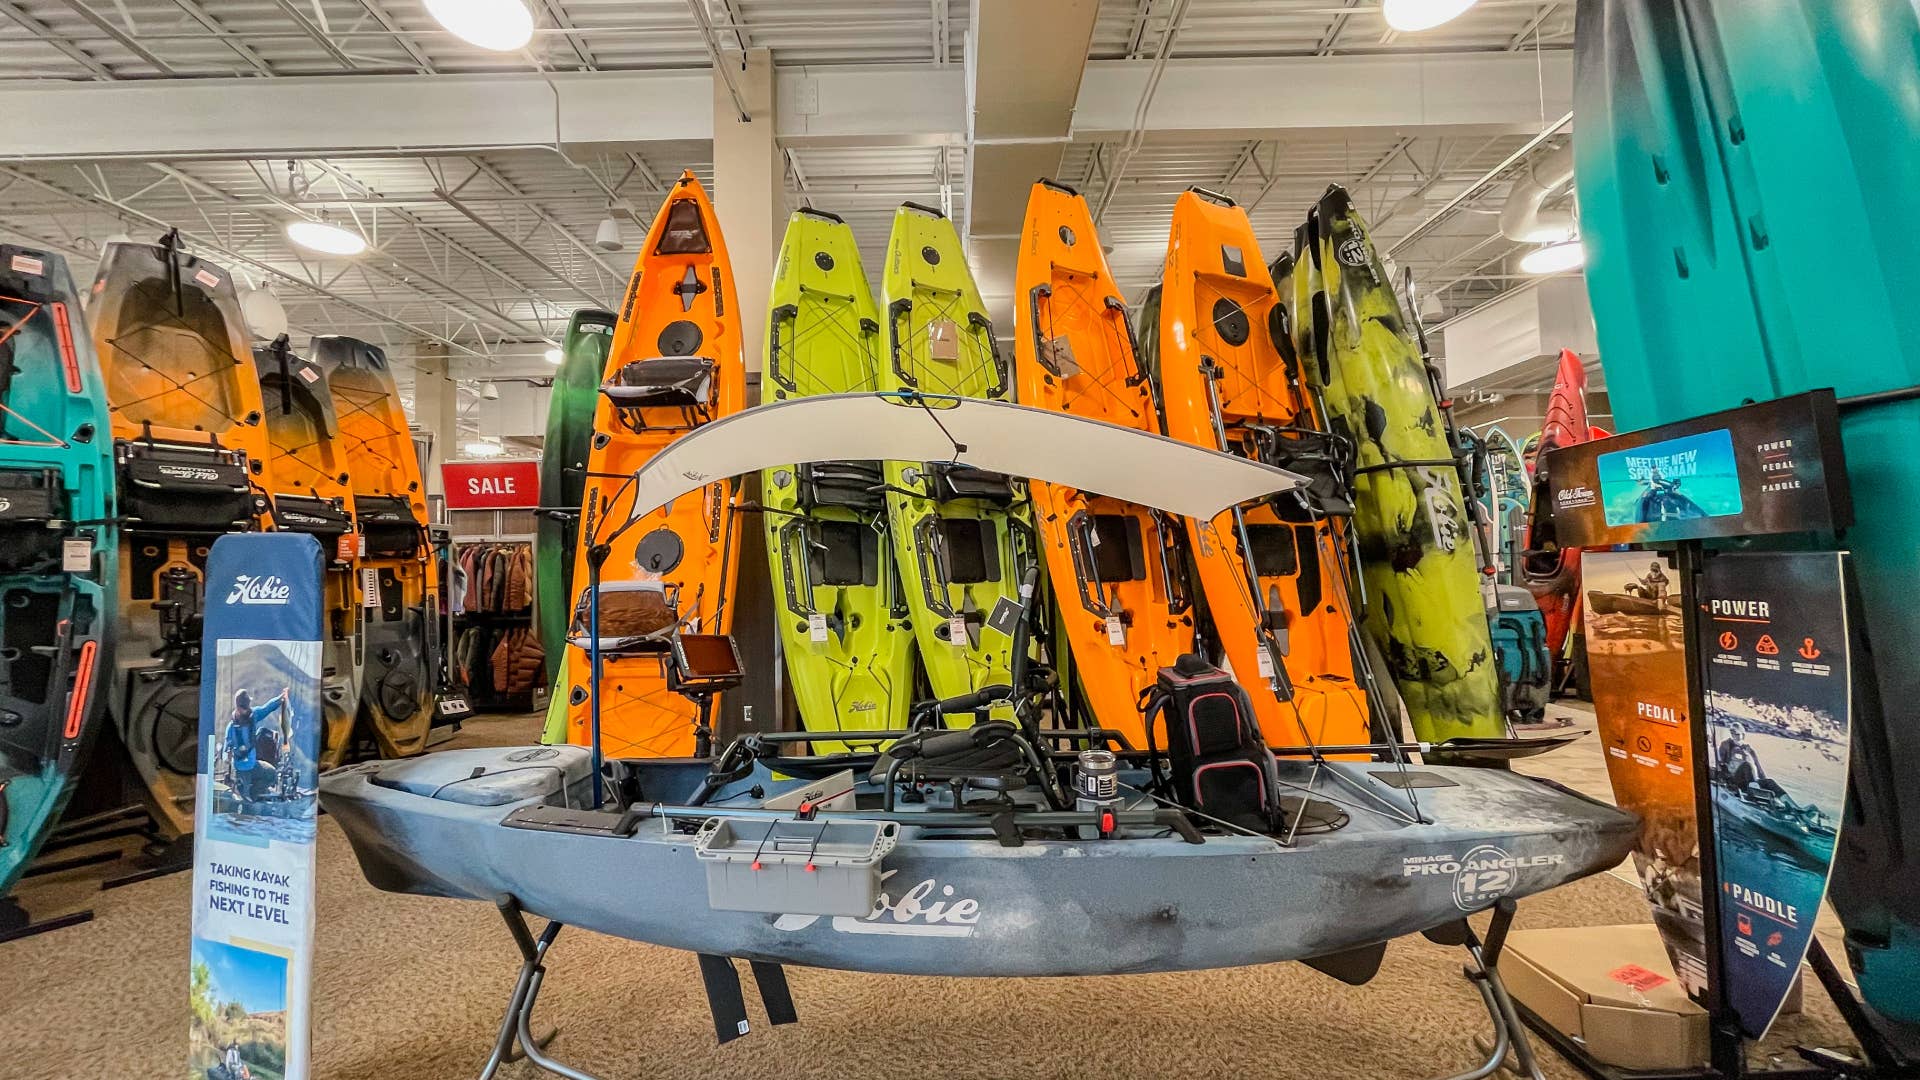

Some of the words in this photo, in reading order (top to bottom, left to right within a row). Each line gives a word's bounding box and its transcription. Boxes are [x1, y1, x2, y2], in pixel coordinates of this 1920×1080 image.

[1757, 439, 1792, 453] POWER
[1625, 456, 1652, 468] MEET
[1653, 456, 1670, 468] THE
[1671, 449, 1698, 465] NEW
[1762, 460, 1795, 472] PEDAL
[1628, 461, 1697, 480] SPOSMAN
[467, 477, 516, 495] SALE
[1558, 488, 1574, 501] Old
[1762, 480, 1801, 492] PADDLE
[1416, 466, 1459, 552] Hobie
[225, 574, 290, 605] Hobie
[1711, 599, 1770, 618] POWER
[1637, 701, 1678, 723] PEDAL
[1403, 854, 1456, 865] MIRAGE
[1403, 862, 1461, 877] PRO
[1463, 854, 1565, 872] ANGLER
[210, 862, 251, 880] TAKING
[253, 869, 290, 888] KAYAK
[1459, 870, 1510, 894] 12
[209, 879, 250, 897] FISHING
[252, 887, 267, 900] TO
[268, 890, 290, 906] THE
[773, 869, 981, 937] obie
[1732, 883, 1799, 923] PADDLE
[209, 894, 245, 915] NEXT
[247, 902, 290, 925] LEVEL
